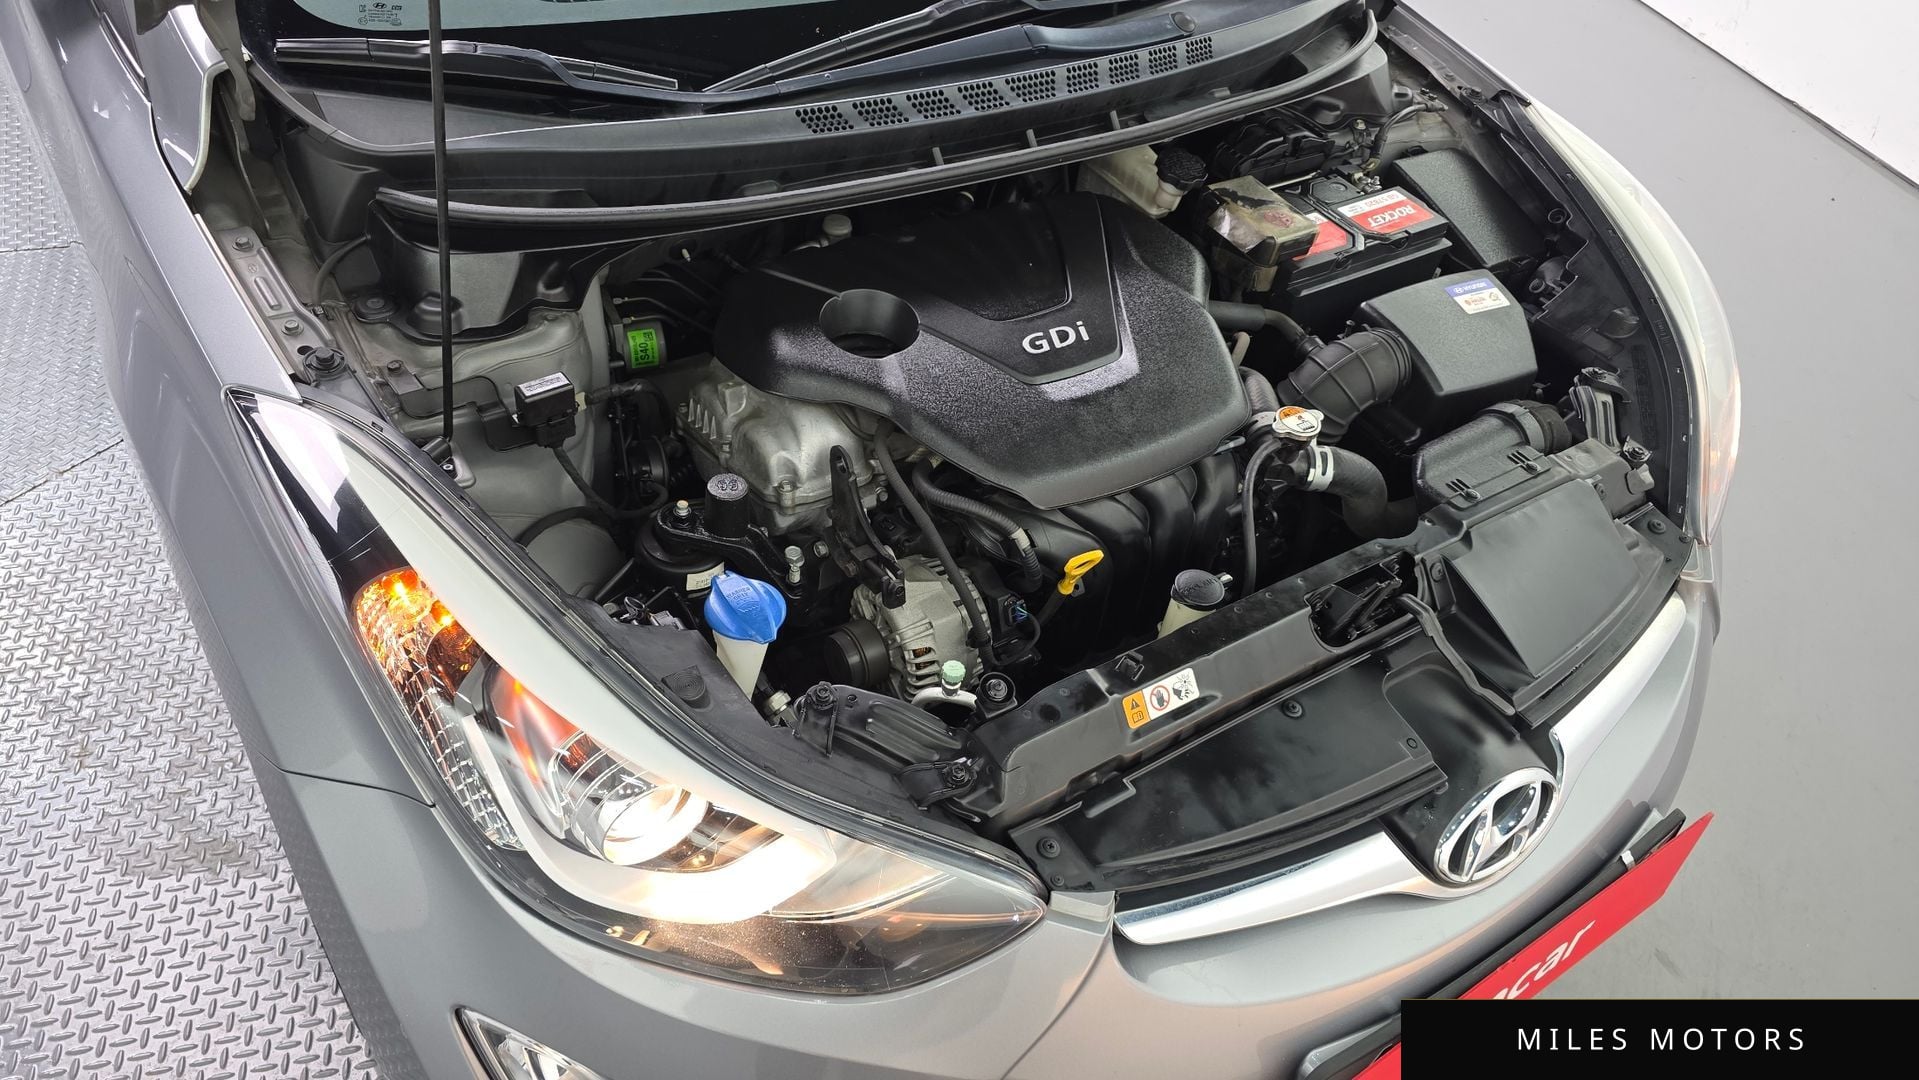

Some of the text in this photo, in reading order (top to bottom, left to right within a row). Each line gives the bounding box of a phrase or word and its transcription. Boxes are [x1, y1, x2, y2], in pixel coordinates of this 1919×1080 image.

[1367, 205, 1417, 227] ROCKET
[1022, 320, 1090, 354] GDi
[638, 342, 650, 360] S40
